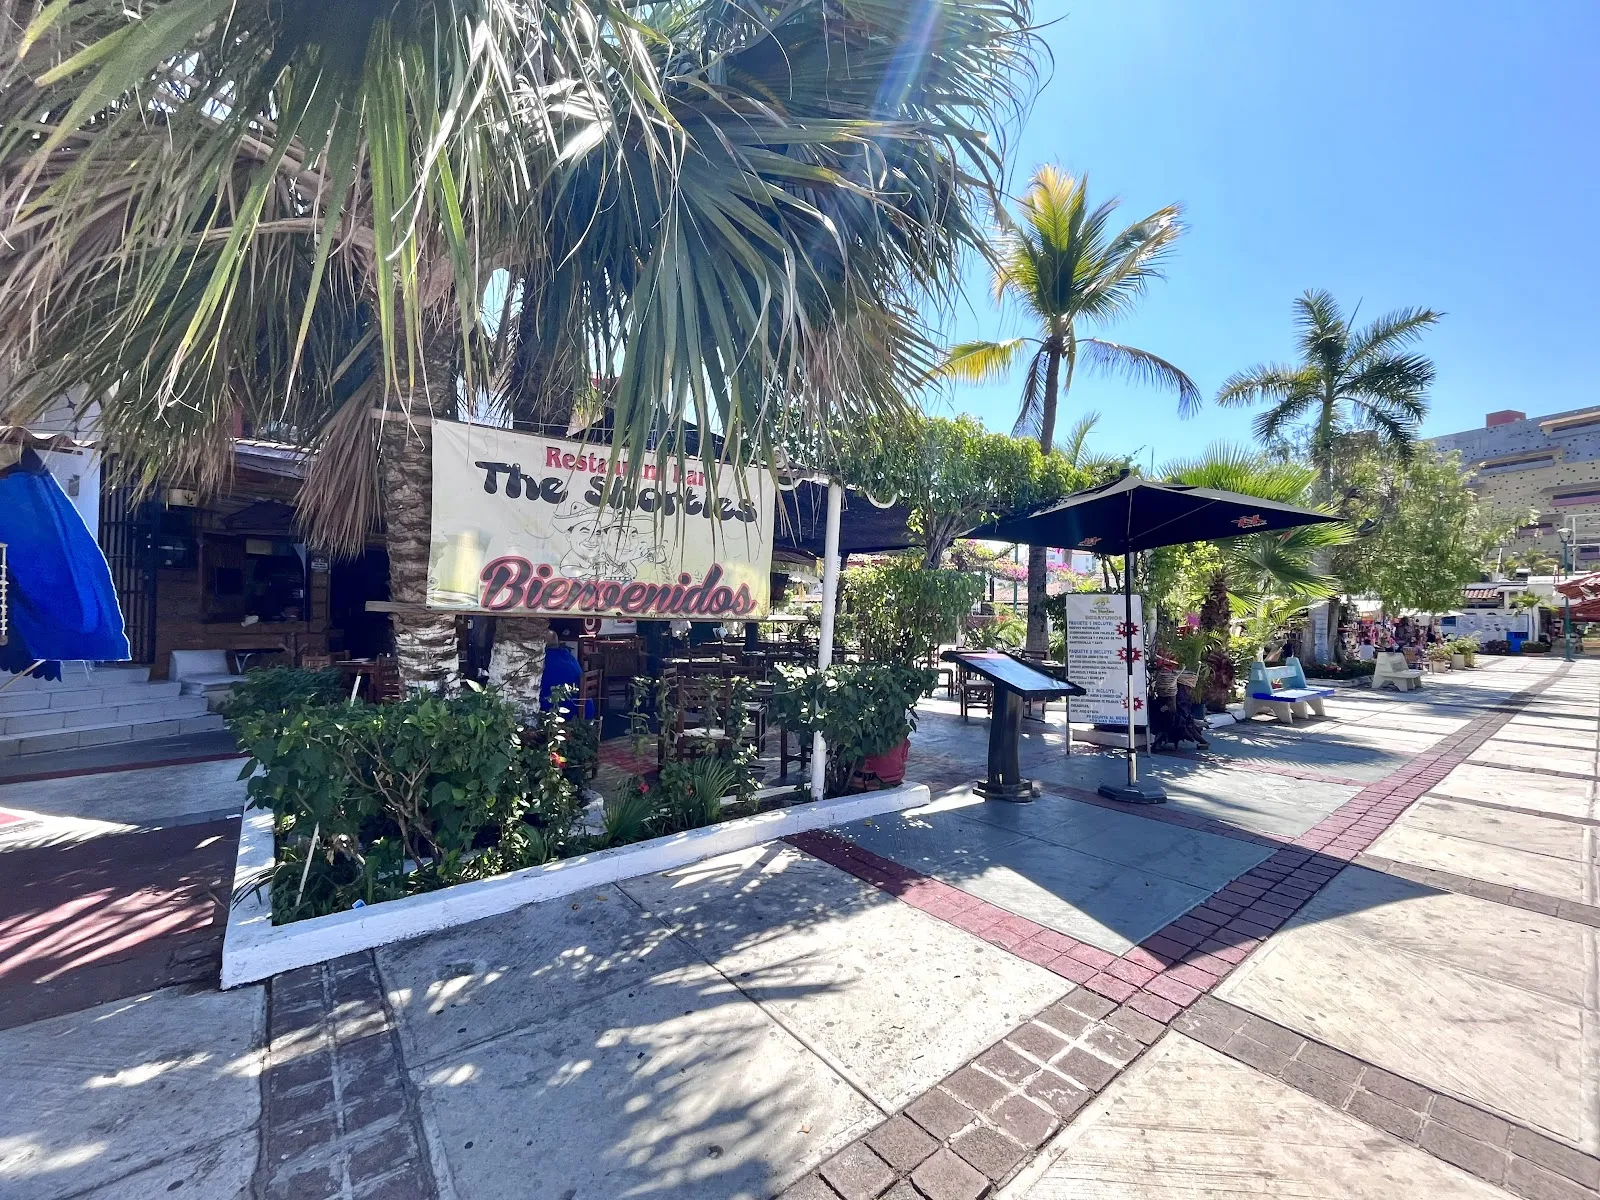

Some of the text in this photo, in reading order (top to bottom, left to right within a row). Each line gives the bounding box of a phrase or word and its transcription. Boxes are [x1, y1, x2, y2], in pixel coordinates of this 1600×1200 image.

[475, 461, 757, 523] The Shorties
[545, 446, 664, 482] Restaun
[479, 556, 757, 615] Bienvenidos
